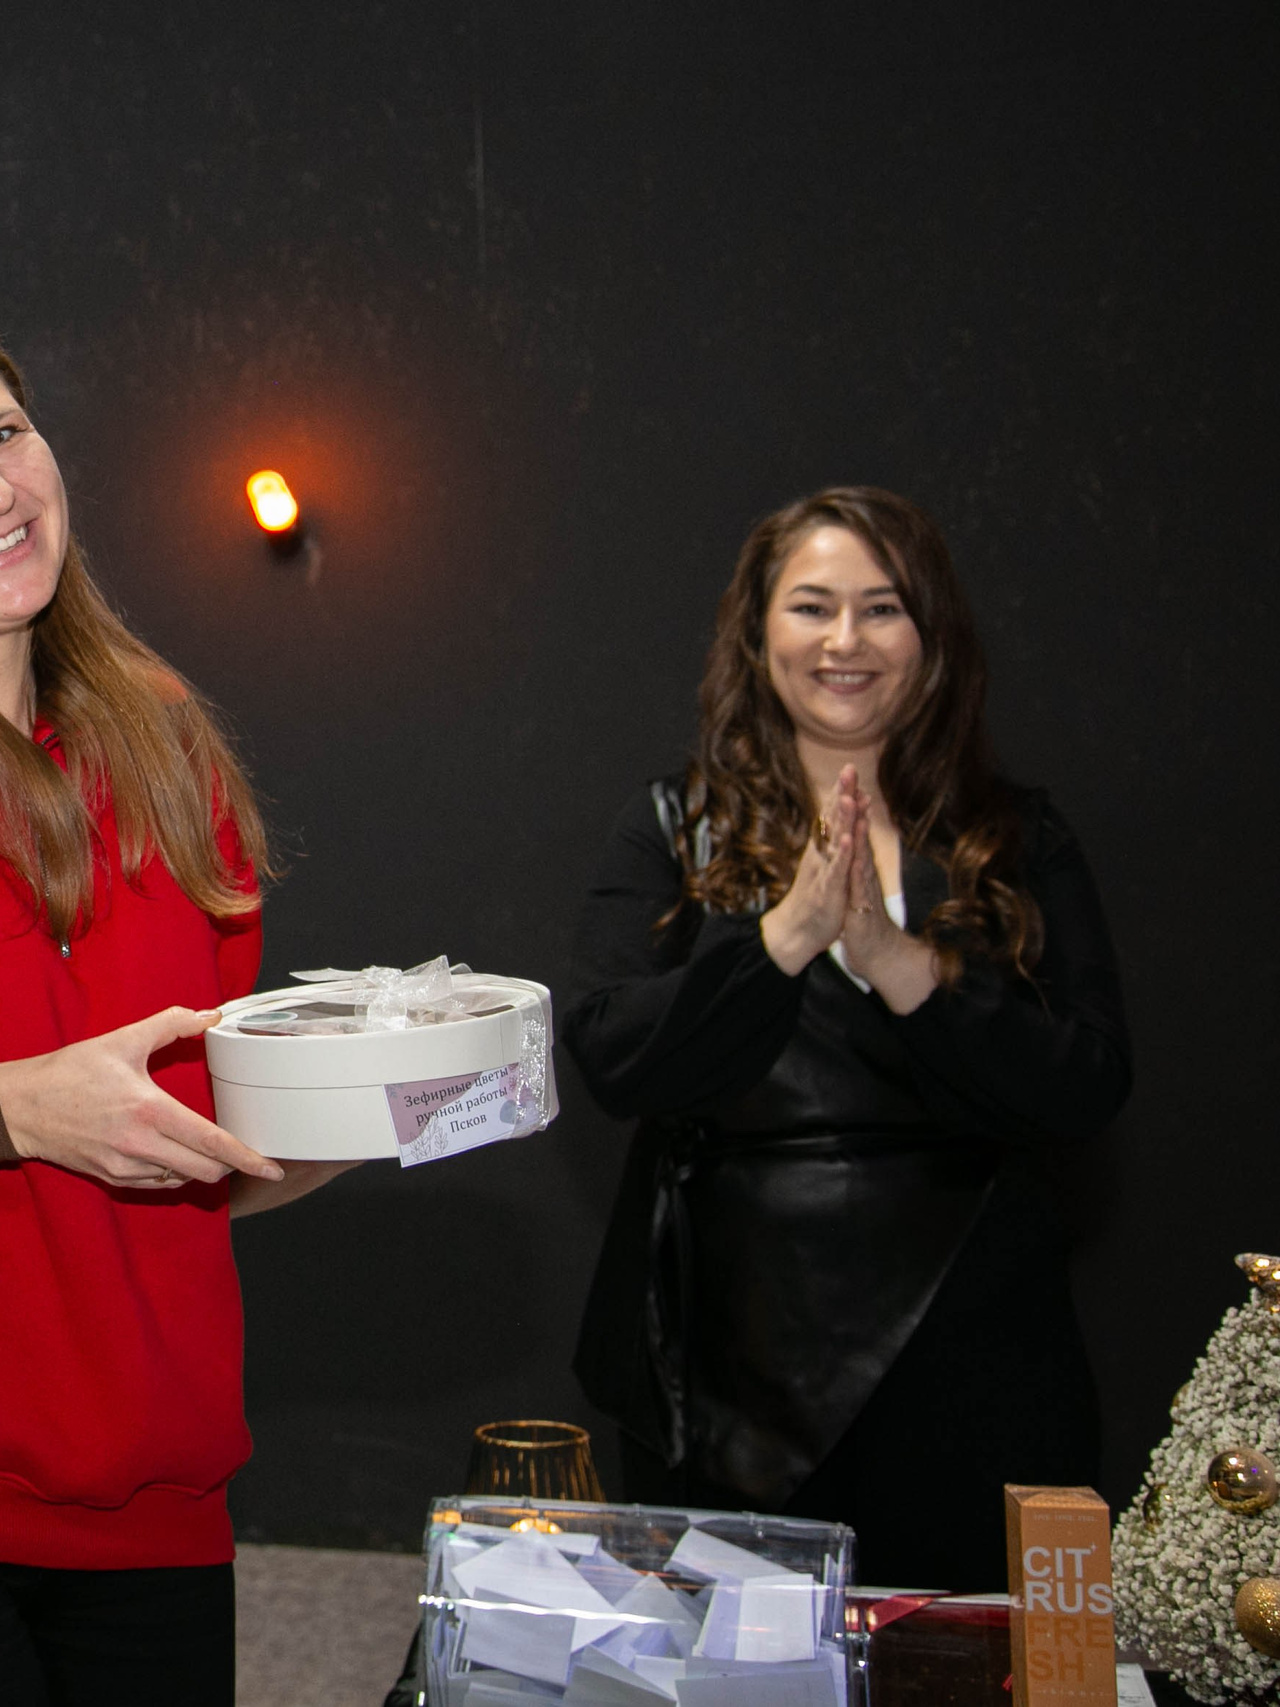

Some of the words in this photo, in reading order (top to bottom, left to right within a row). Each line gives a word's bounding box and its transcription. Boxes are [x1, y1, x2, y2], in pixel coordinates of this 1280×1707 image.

[404, 1080, 472, 1108] Зефирные
[475, 1068, 509, 1087] цветы
[416, 1101, 464, 1126] ручной
[466, 1087, 508, 1112] работы
[450, 1113, 488, 1133] Псков
[1023, 1546, 1092, 1579] CIT
[1025, 1581, 1114, 1615] RUS
[1027, 1616, 1112, 1649] FRE
[1028, 1651, 1085, 1682] SH
